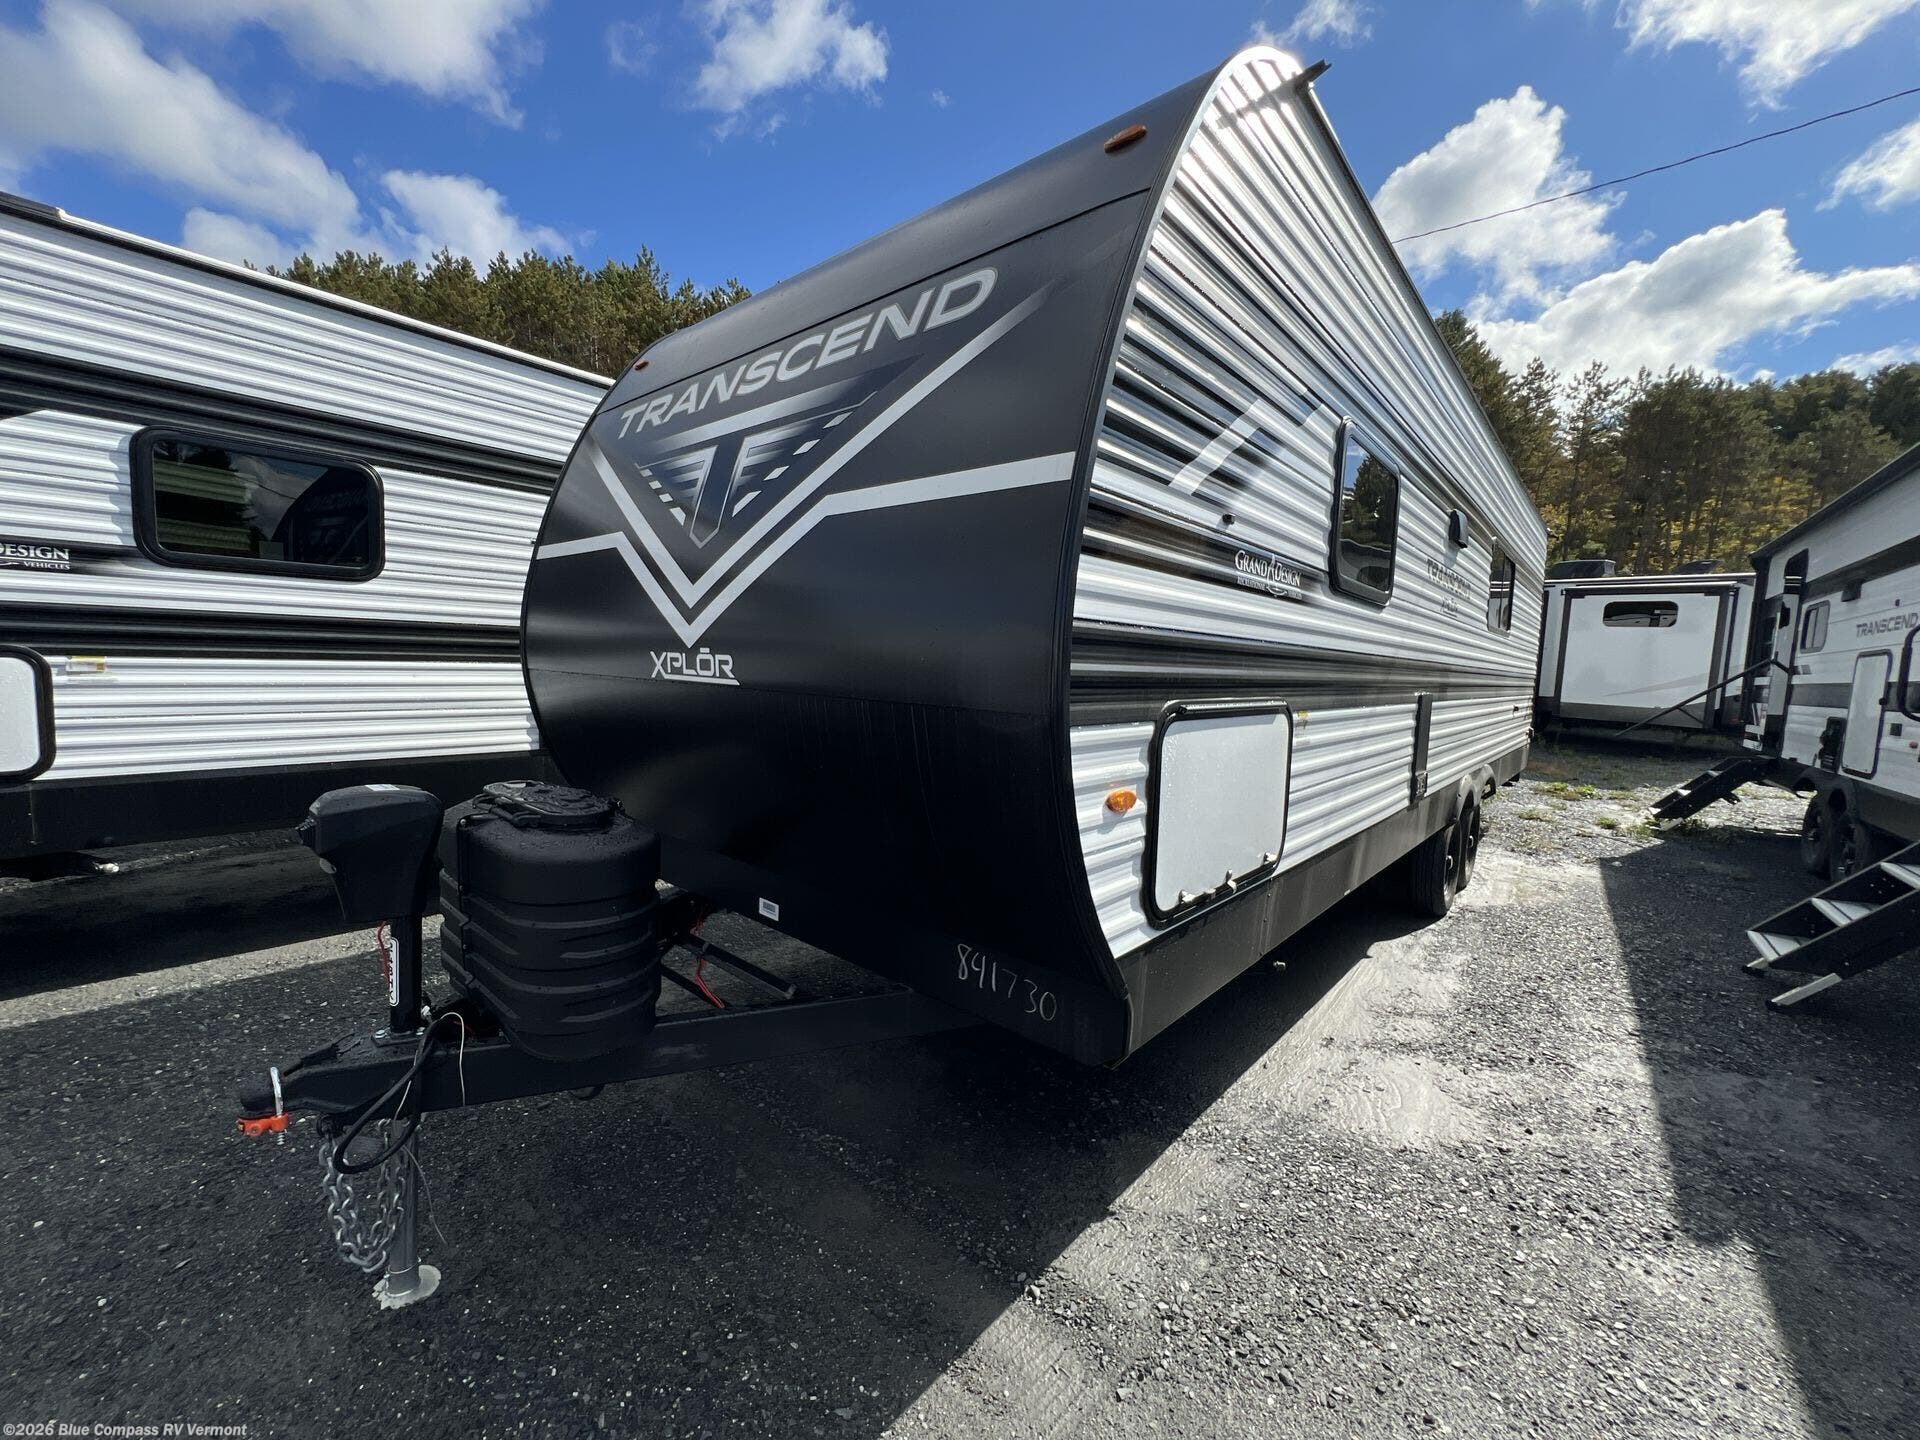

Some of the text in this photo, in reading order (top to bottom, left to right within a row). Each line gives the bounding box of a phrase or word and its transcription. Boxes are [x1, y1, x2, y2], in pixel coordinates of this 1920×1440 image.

[617, 266, 998, 440] TRANSCEND
[23, 561, 70, 570] VEHICLES
[1234, 549, 1302, 587] GRAND DESIGN
[1856, 612, 1919, 638] TRANSCEND
